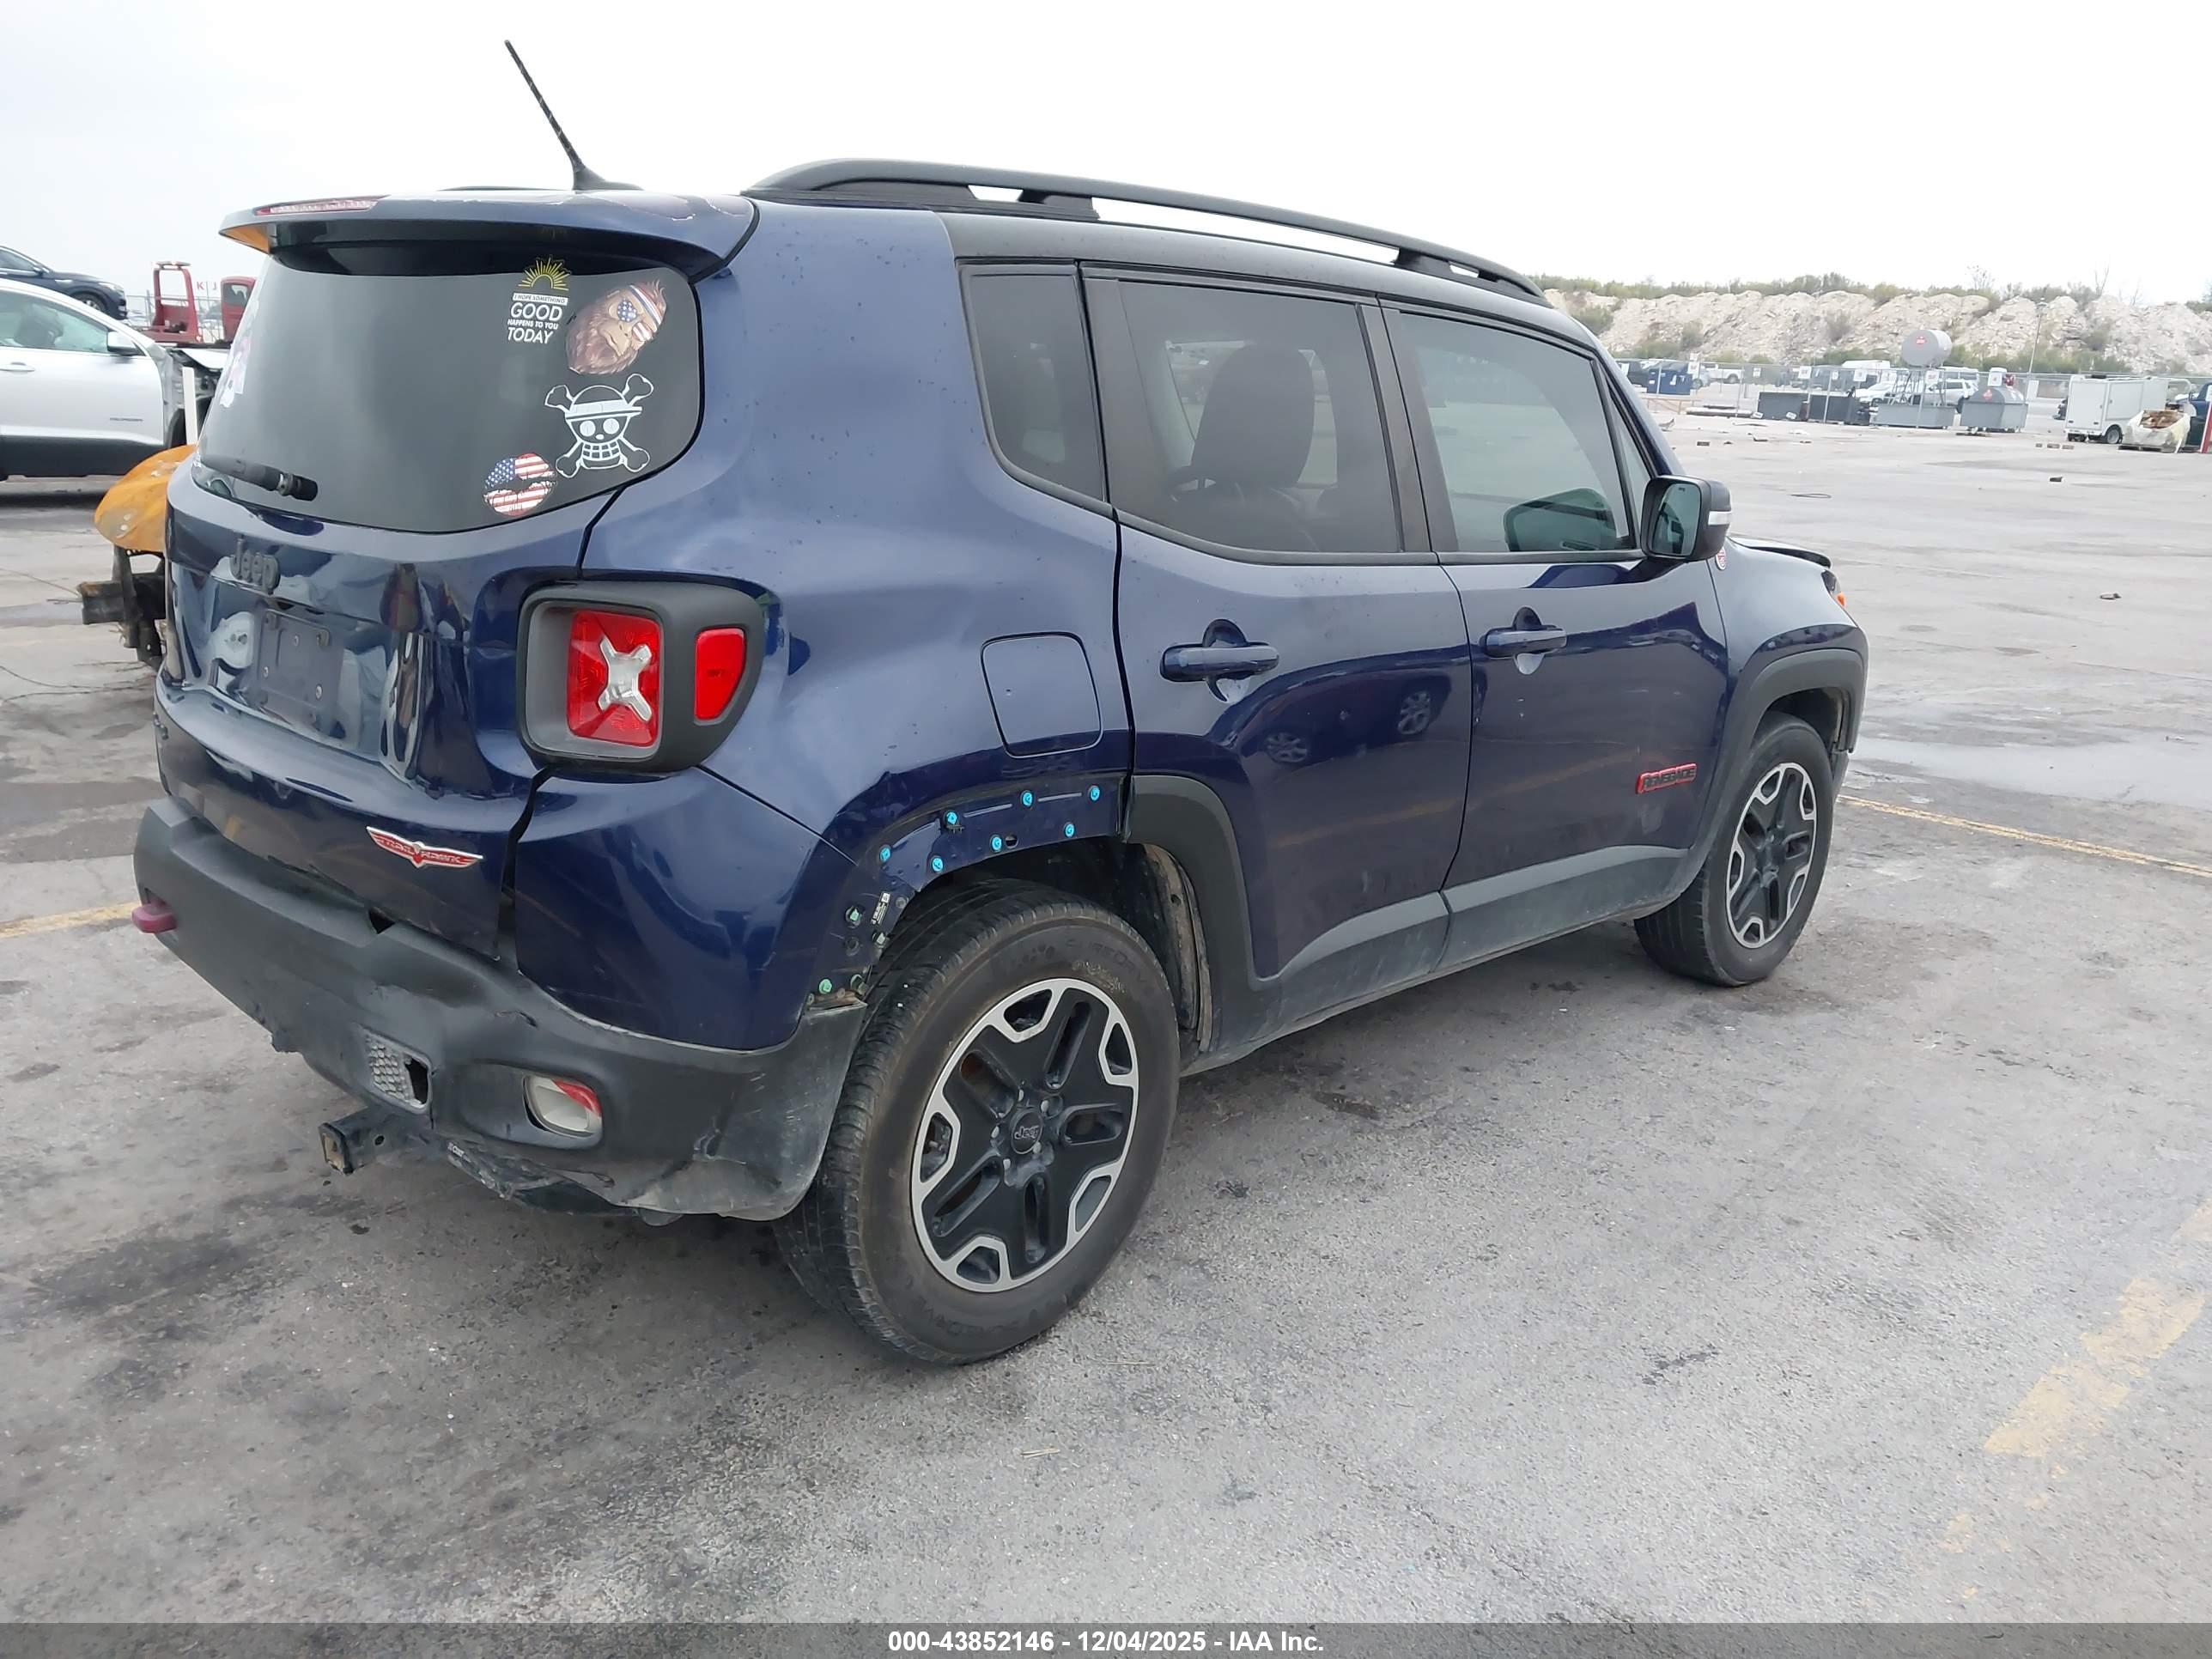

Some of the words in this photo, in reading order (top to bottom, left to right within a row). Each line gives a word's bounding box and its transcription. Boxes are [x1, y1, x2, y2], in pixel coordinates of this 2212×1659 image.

[532, 295, 566, 304] SOMETHING
[511, 302, 562, 321] GOOD
[507, 319, 533, 327] HAPPENS
[507, 326, 554, 343] TODAY
[230, 538, 280, 592] Jeep
